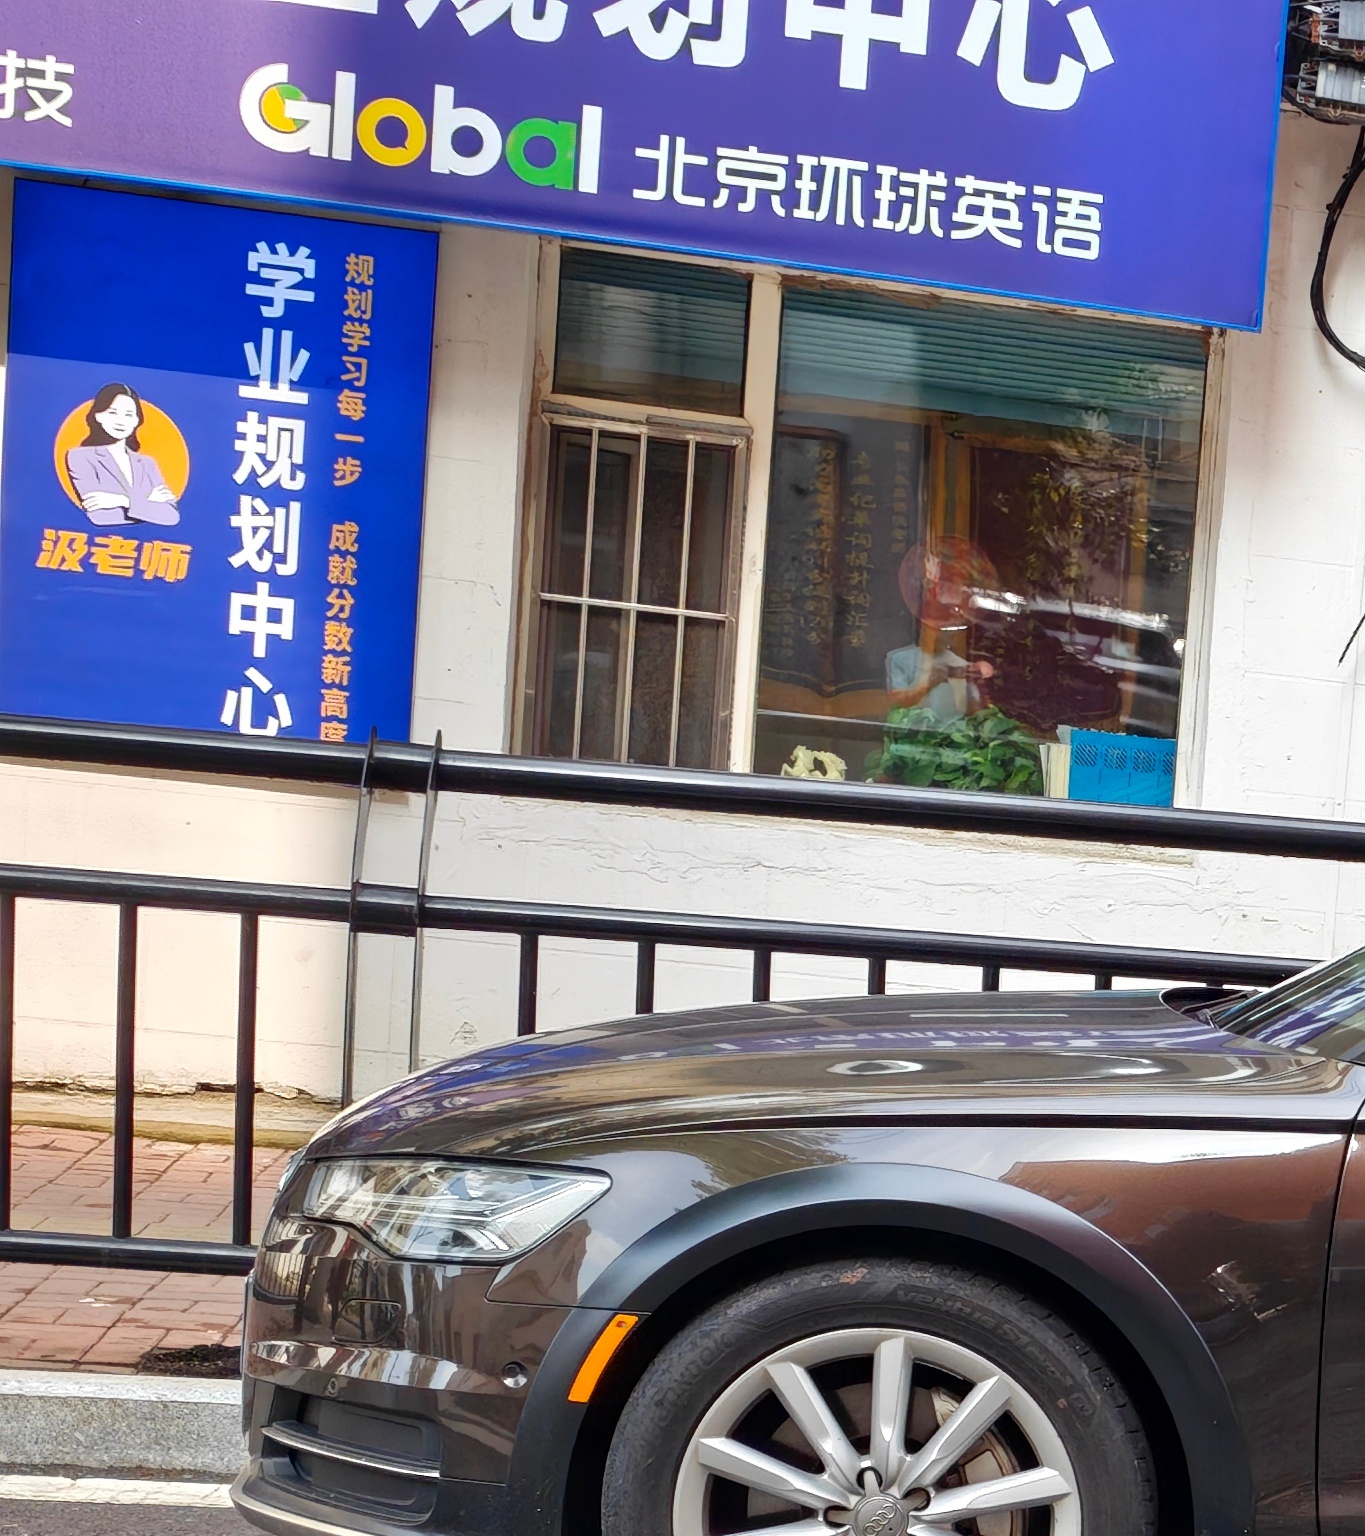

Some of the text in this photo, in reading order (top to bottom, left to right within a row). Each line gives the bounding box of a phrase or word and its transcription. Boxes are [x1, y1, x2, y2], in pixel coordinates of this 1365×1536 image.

[239, 62, 1104, 261] Global 北京环球英语
[331, 252, 375, 488] 规划学习每一步
[35, 527, 192, 585] 汲老师
[219, 240, 316, 737] 学业规划中心
